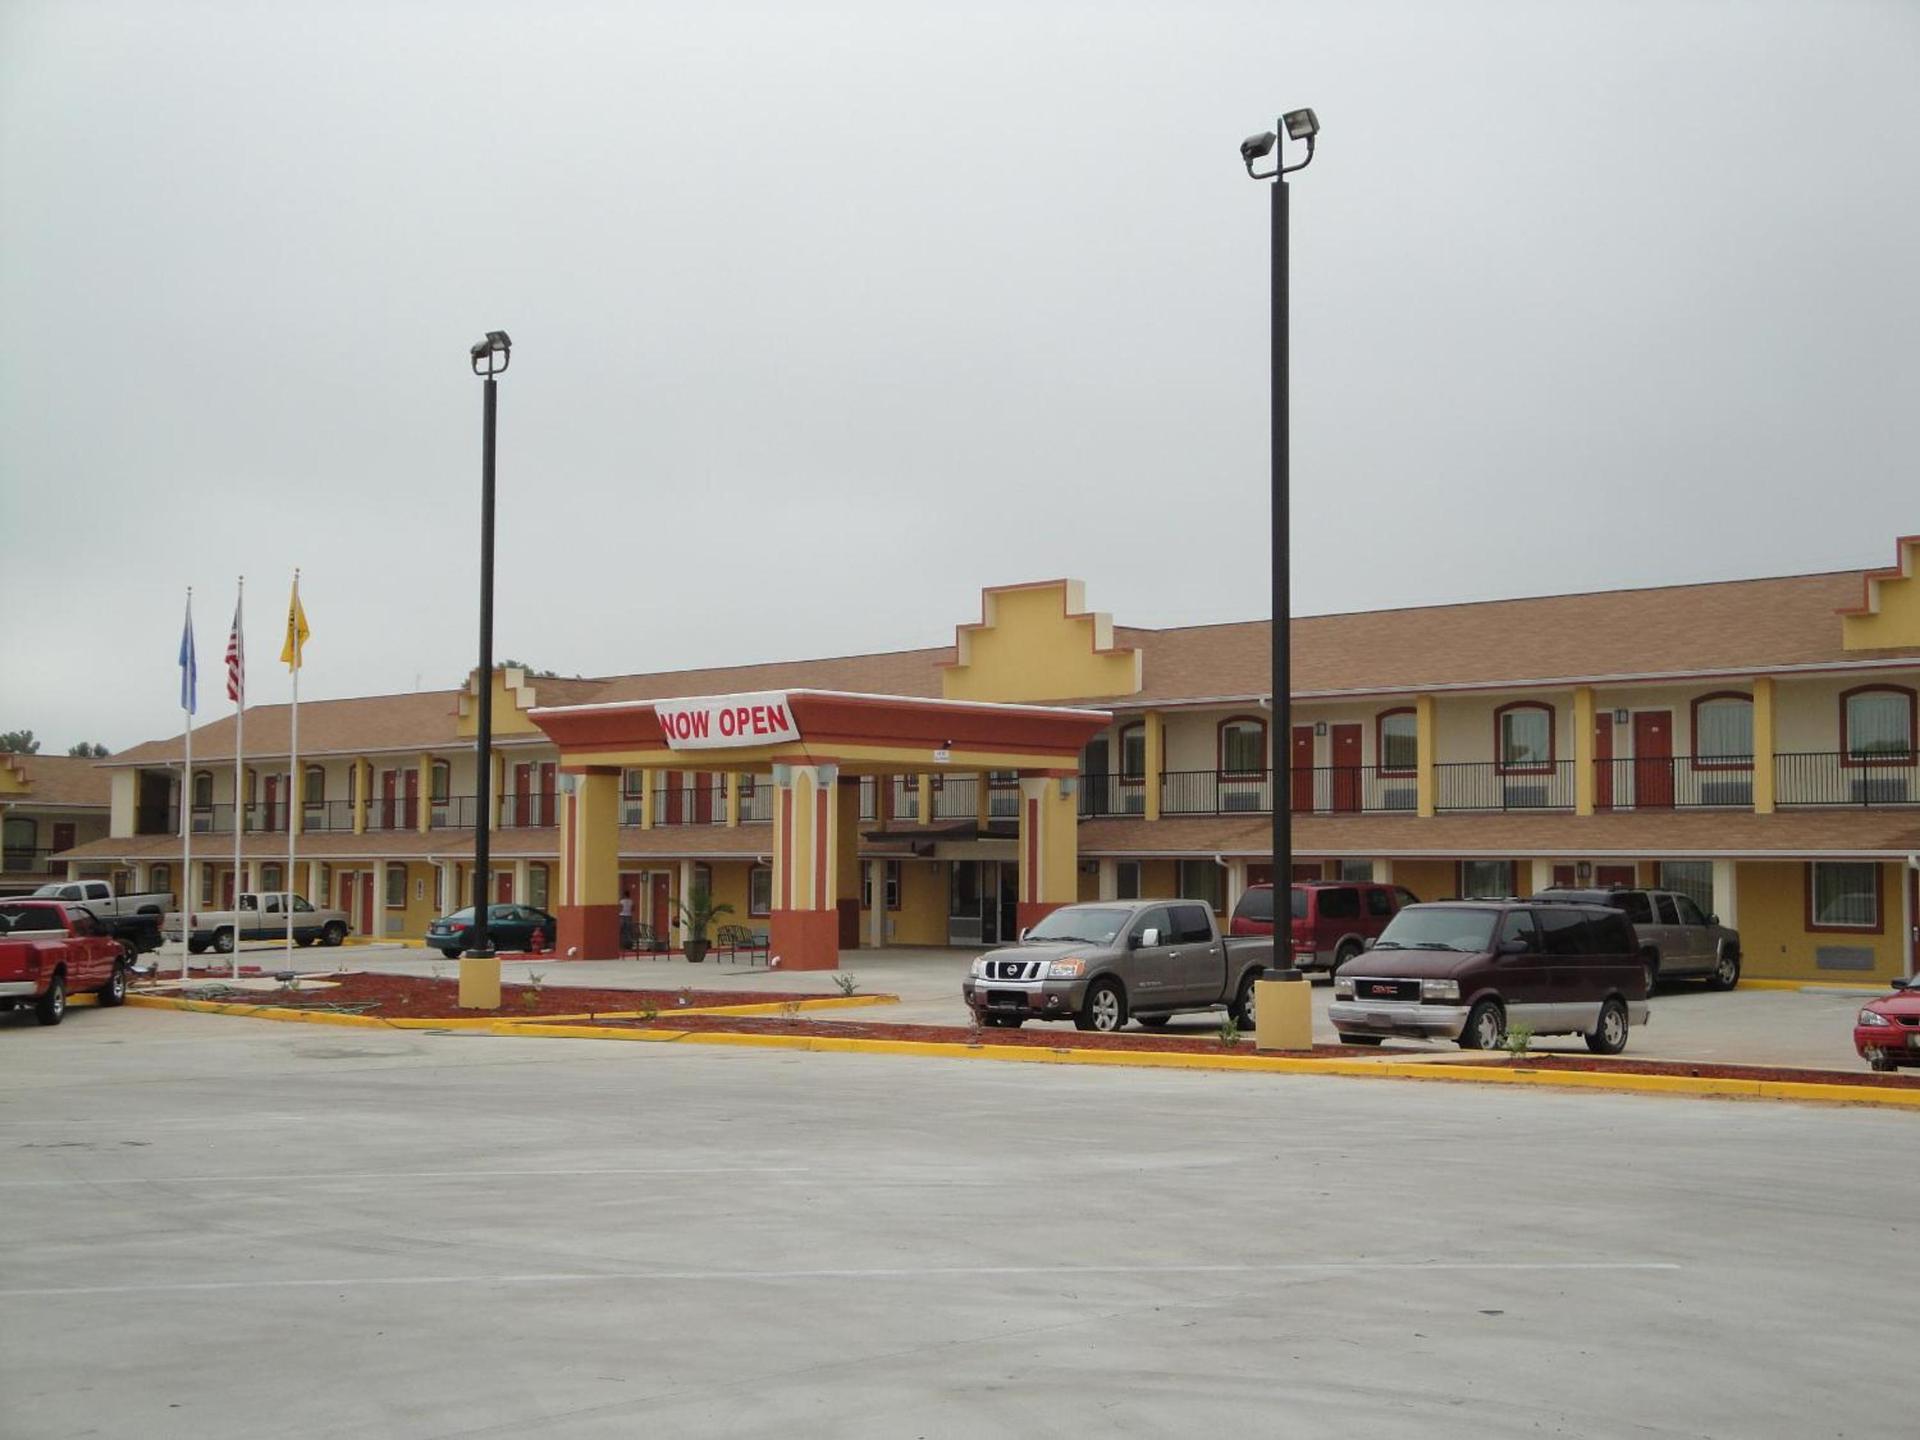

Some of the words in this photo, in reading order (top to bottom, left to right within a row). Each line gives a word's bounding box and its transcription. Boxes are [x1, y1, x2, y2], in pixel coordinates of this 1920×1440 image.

[660, 711, 709, 739] NOW
[719, 704, 789, 736] OPEN
[1371, 984, 1399, 995] GMC
